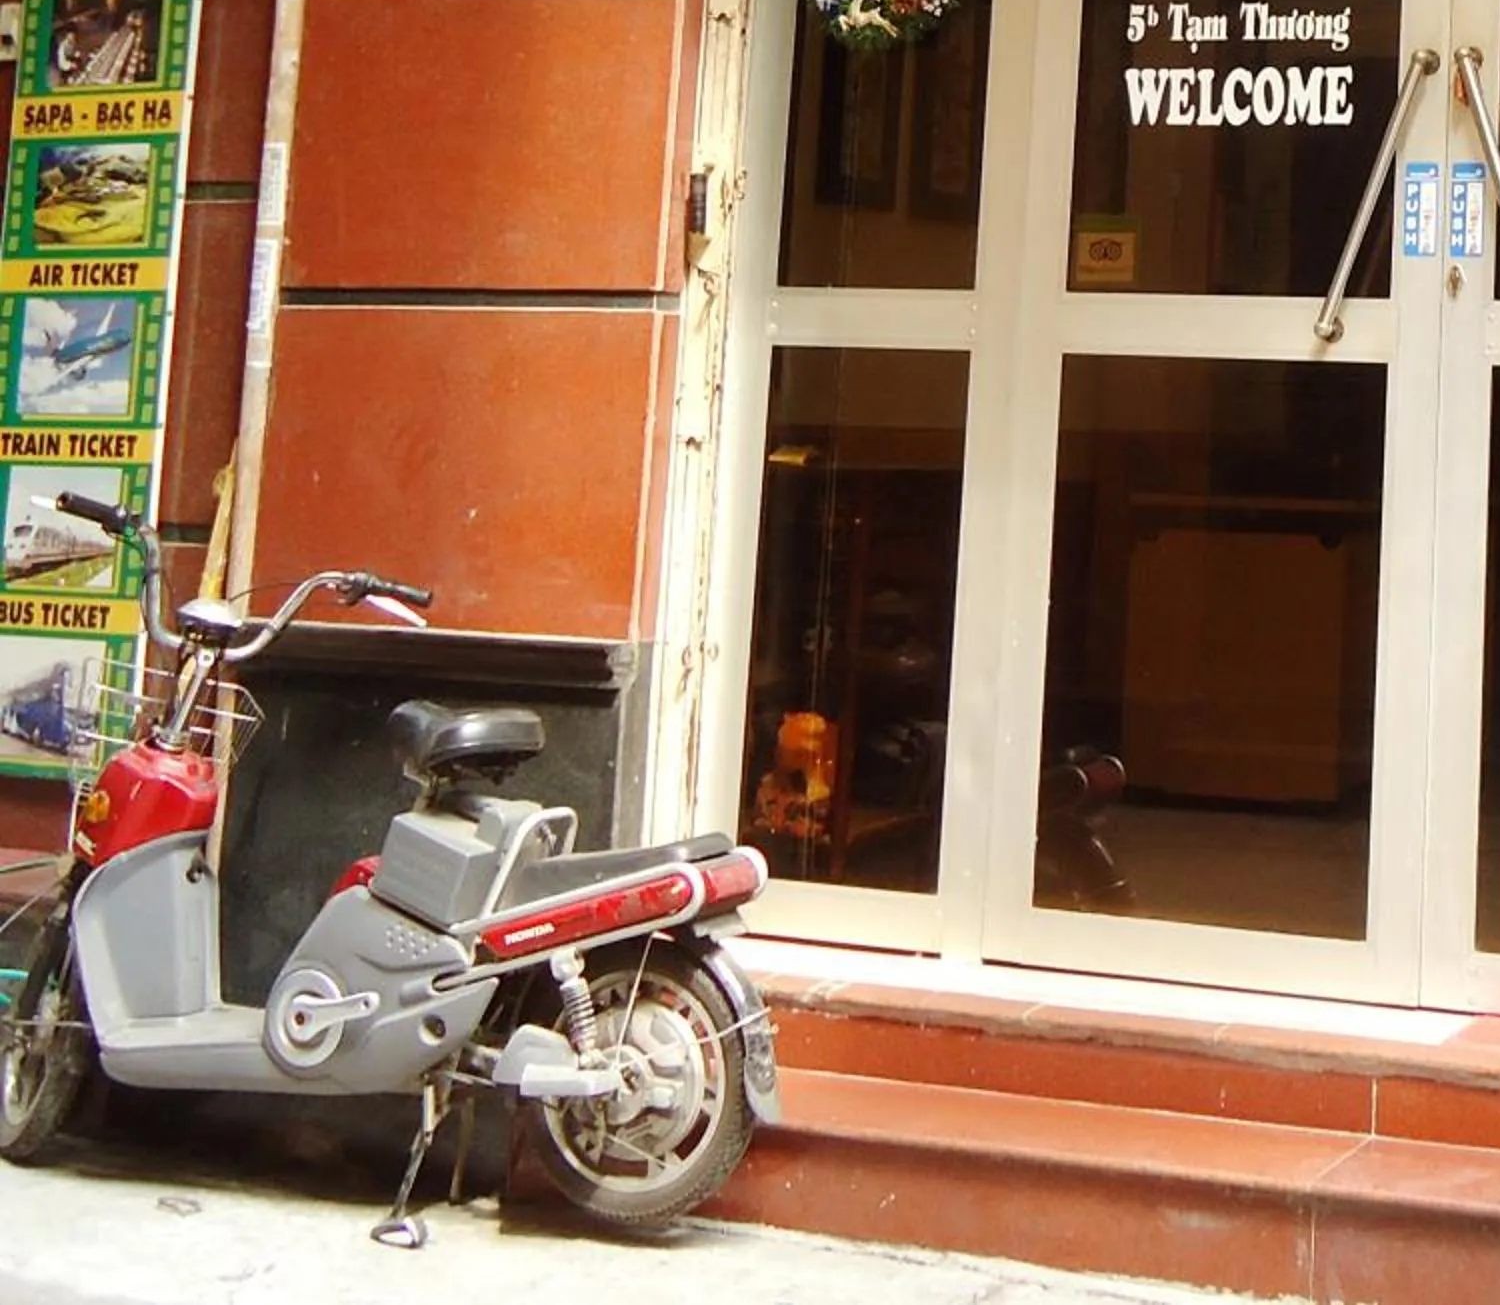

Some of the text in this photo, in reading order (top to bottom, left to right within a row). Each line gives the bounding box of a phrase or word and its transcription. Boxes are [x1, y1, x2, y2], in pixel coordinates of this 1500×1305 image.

[1167, 2, 1229, 54] Tạm
[1240, 2, 1351, 51] Thương
[1124, 65, 1354, 127] WELCOME
[23, 102, 74, 127] SAPA
[96, 100, 136, 124] BAC
[142, 98, 172, 122] HA
[28, 262, 140, 287] AIR TICKET
[0, 432, 139, 458] TRAIN TICKET
[0, 599, 111, 630] BUS TICKET
